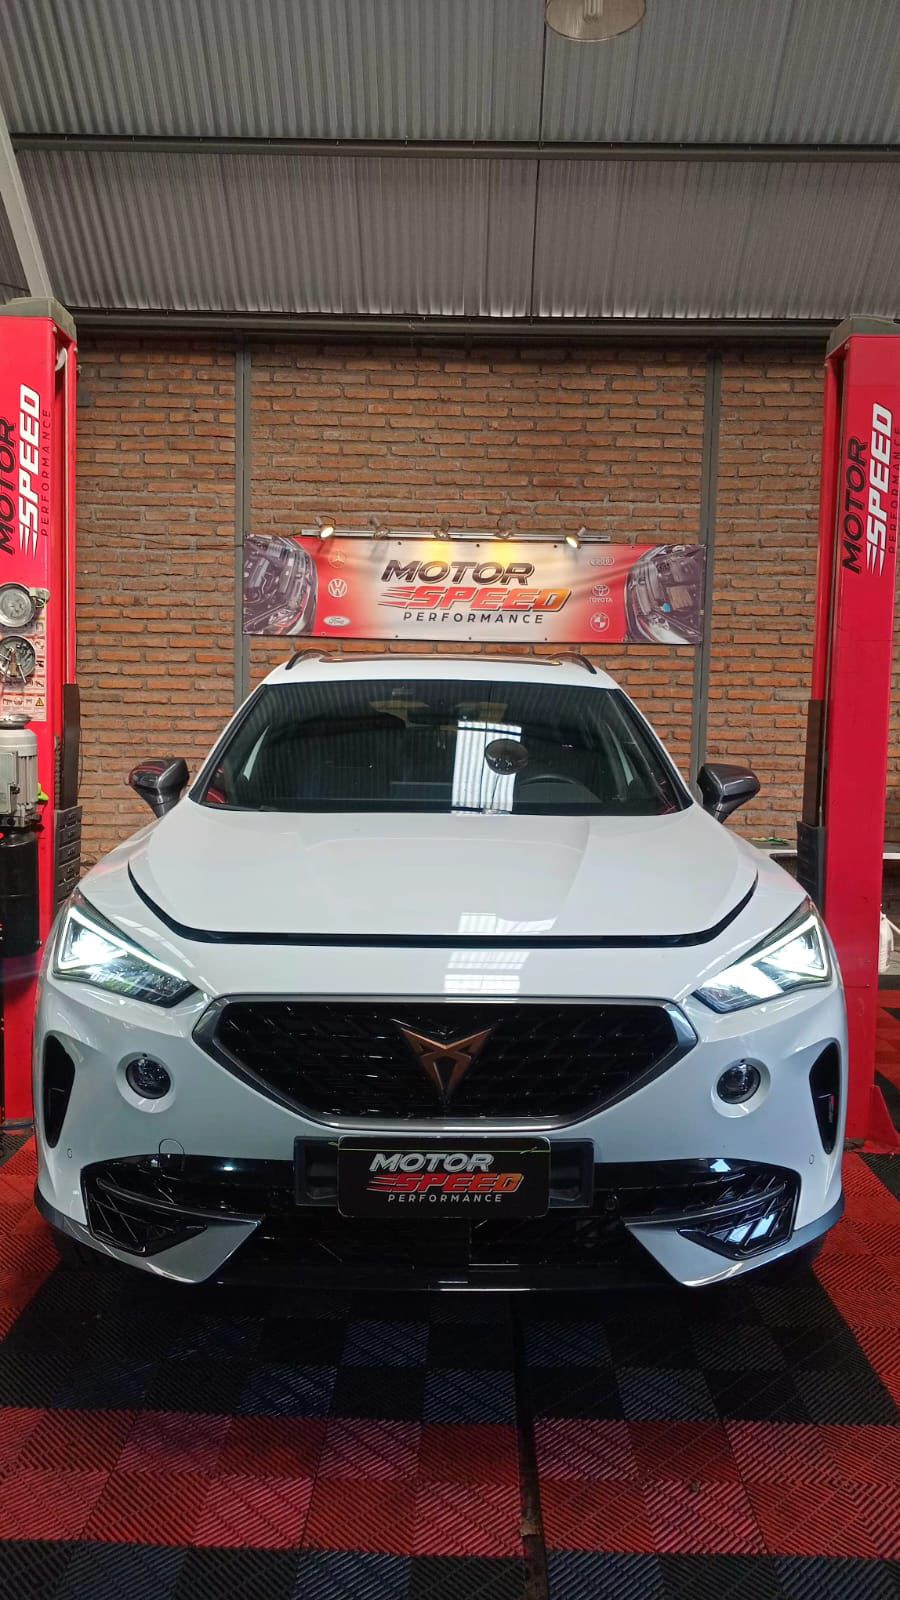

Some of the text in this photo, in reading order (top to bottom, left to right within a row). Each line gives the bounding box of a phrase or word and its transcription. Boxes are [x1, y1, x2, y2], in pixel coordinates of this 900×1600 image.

[18, 383, 41, 533] SPEED
[40, 408, 51, 537] PERFORMANCE
[866, 402, 894, 550] SPEED
[841, 435, 867, 575] MOTOR
[381, 558, 536, 587] MOTOR
[408, 585, 572, 613] SPEED
[403, 611, 544, 625] PERFORMANCE
[368, 1152, 495, 1173] MOTOR
[389, 1172, 525, 1193] SPEED
[387, 1193, 503, 1204] PERFORMANCE
